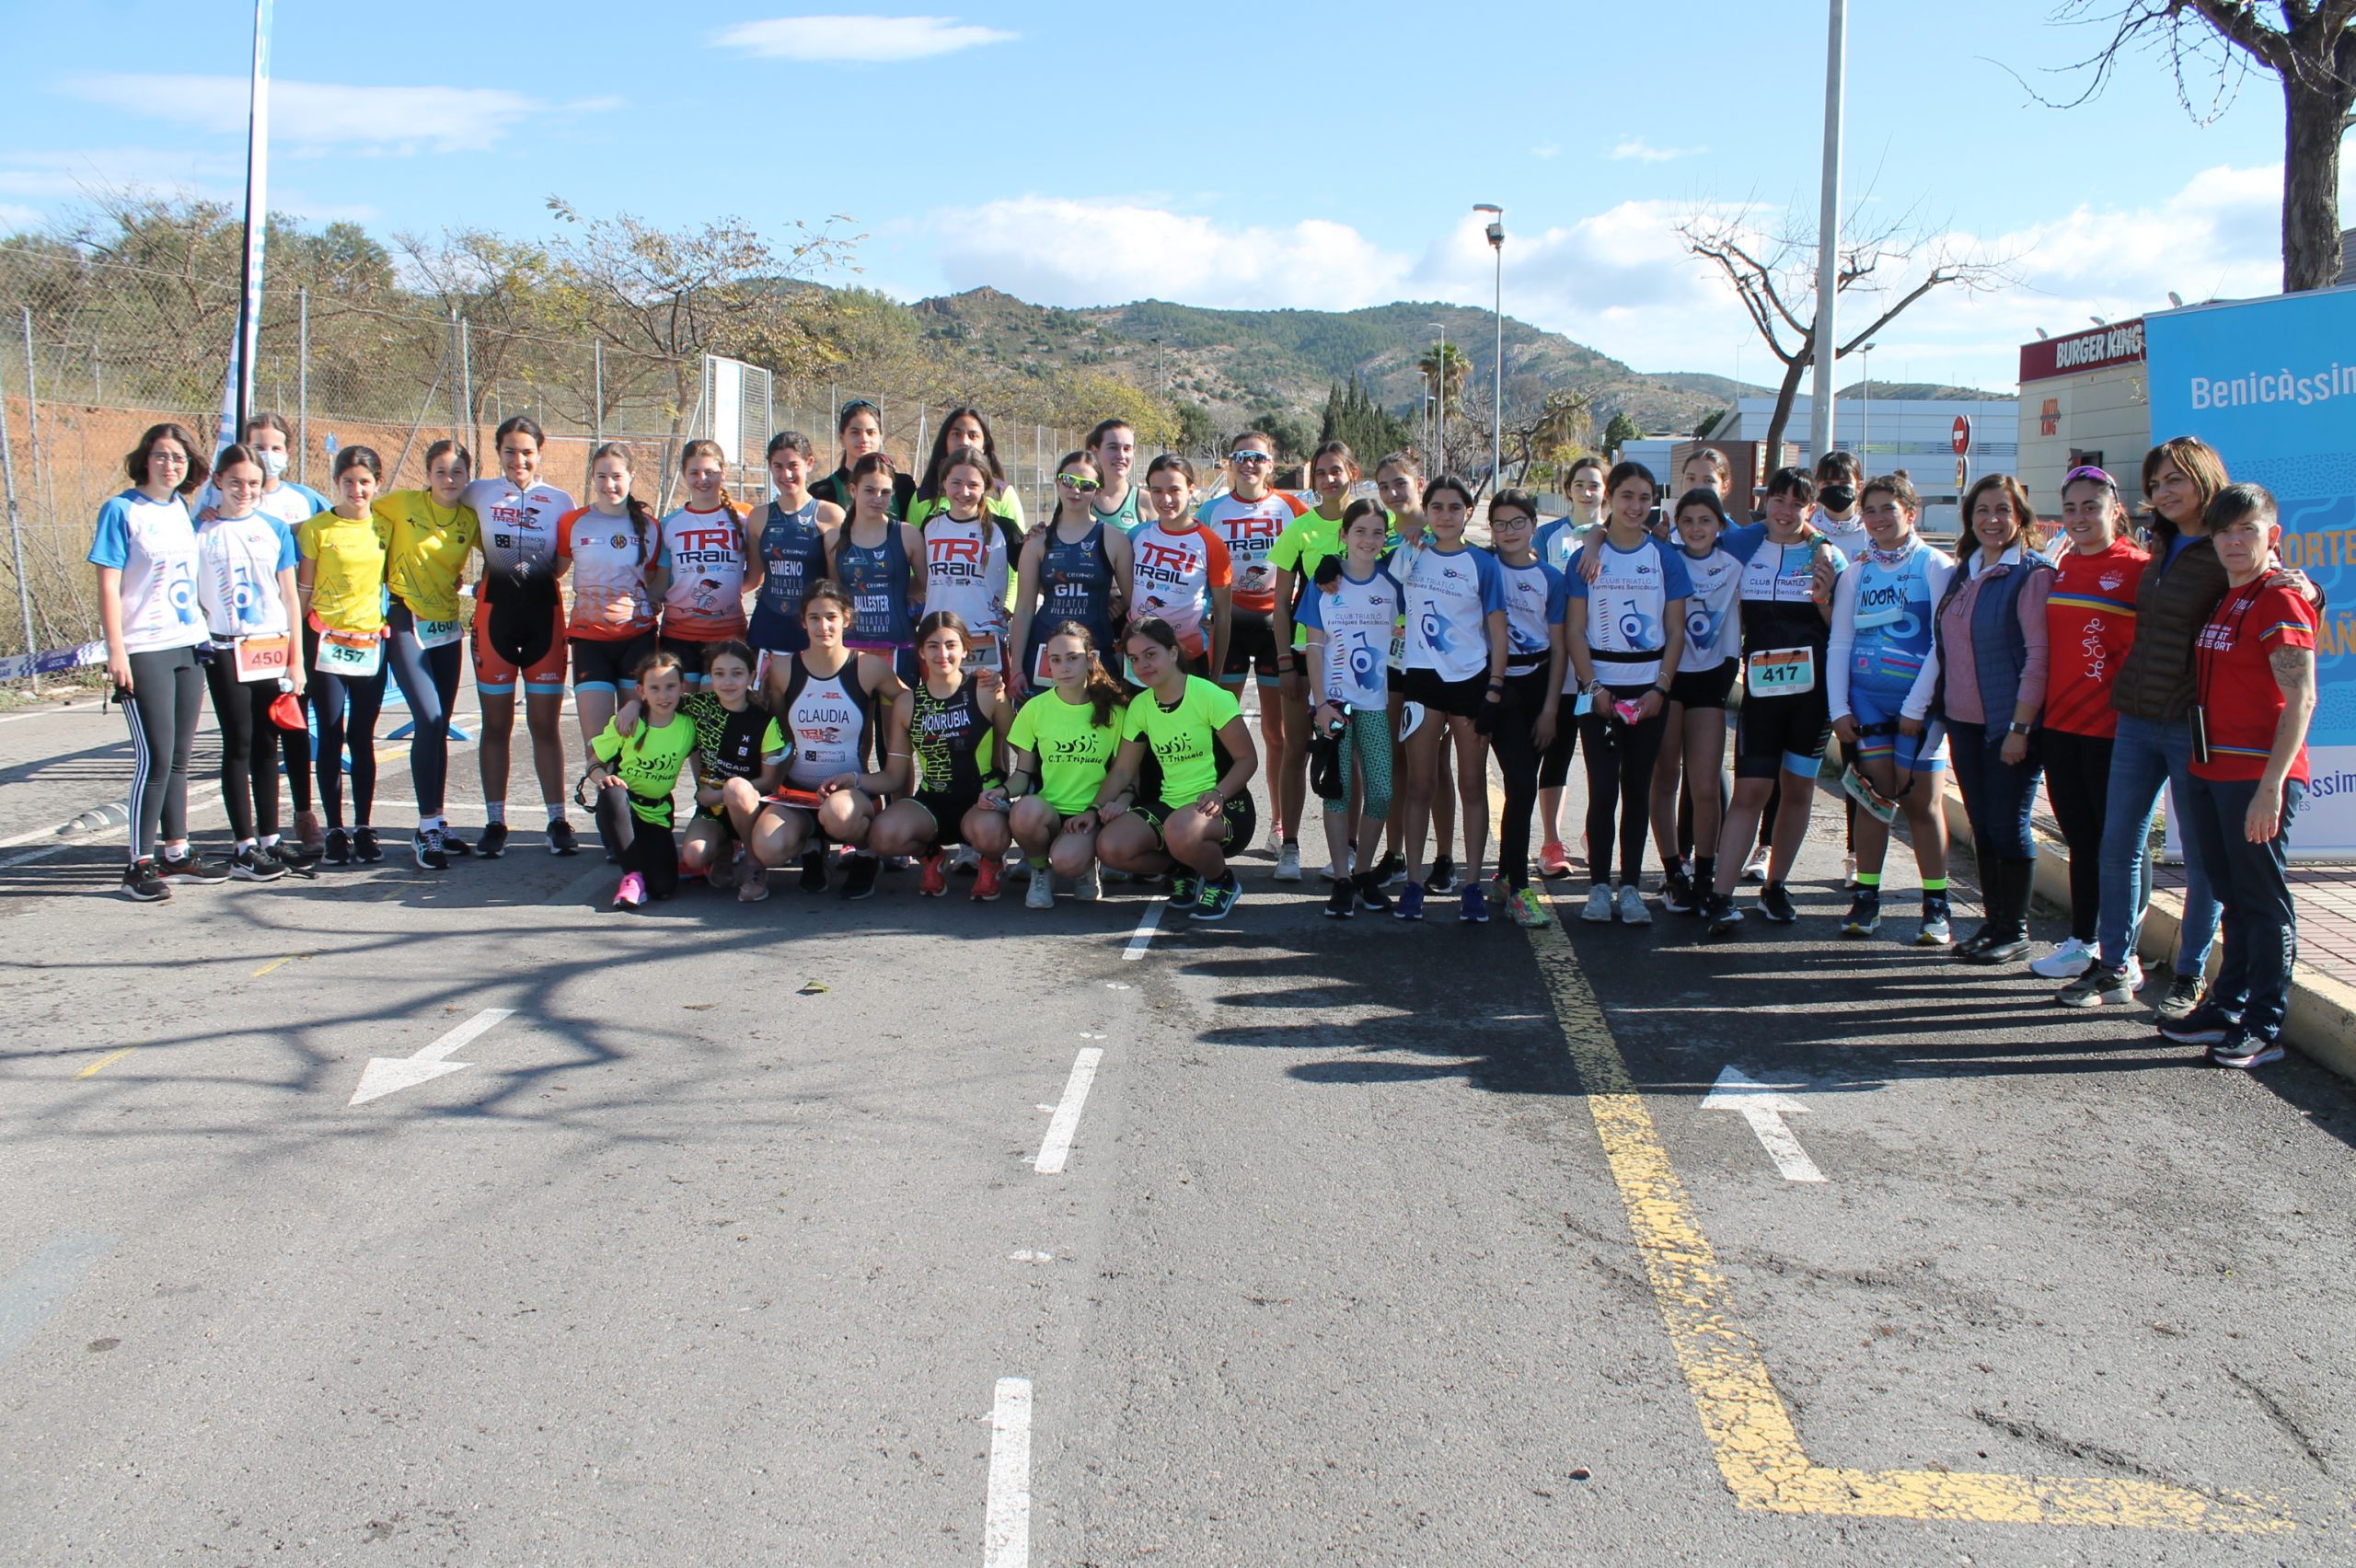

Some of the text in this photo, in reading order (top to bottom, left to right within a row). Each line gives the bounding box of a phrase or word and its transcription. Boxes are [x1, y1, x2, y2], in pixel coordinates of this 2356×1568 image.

[2056, 324, 2142, 368] BURGER KING
[2043, 398, 2058, 415] AUTO
[2040, 418, 2056, 436] KING
[1222, 518, 1283, 539] TRI
[676, 529, 739, 550] TRI
[929, 538, 987, 563] TRI
[1142, 541, 1196, 573] TRI
[769, 560, 803, 576] GIMENO
[1055, 583, 1089, 596] GIL
[1427, 578, 1455, 591] TRIATLÓ
[1777, 578, 1806, 587] TRIATLÓ
[770, 587, 803, 596] VILA-REAL
[1860, 589, 1896, 607] NOOR
[854, 595, 890, 612] BALLESTER
[1050, 607, 1087, 616] VILA-REAL
[427, 620, 453, 634] 460
[856, 625, 890, 633] VILA-REAL
[251, 651, 283, 665] 450
[331, 647, 365, 663] 457
[1762, 665, 1798, 683] 417
[798, 709, 849, 724] CLAUDIA
[920, 709, 971, 732] HONRUBIA
[1067, 755, 1103, 765] Tripicaio
[1168, 751, 1204, 763] Tripicaio
